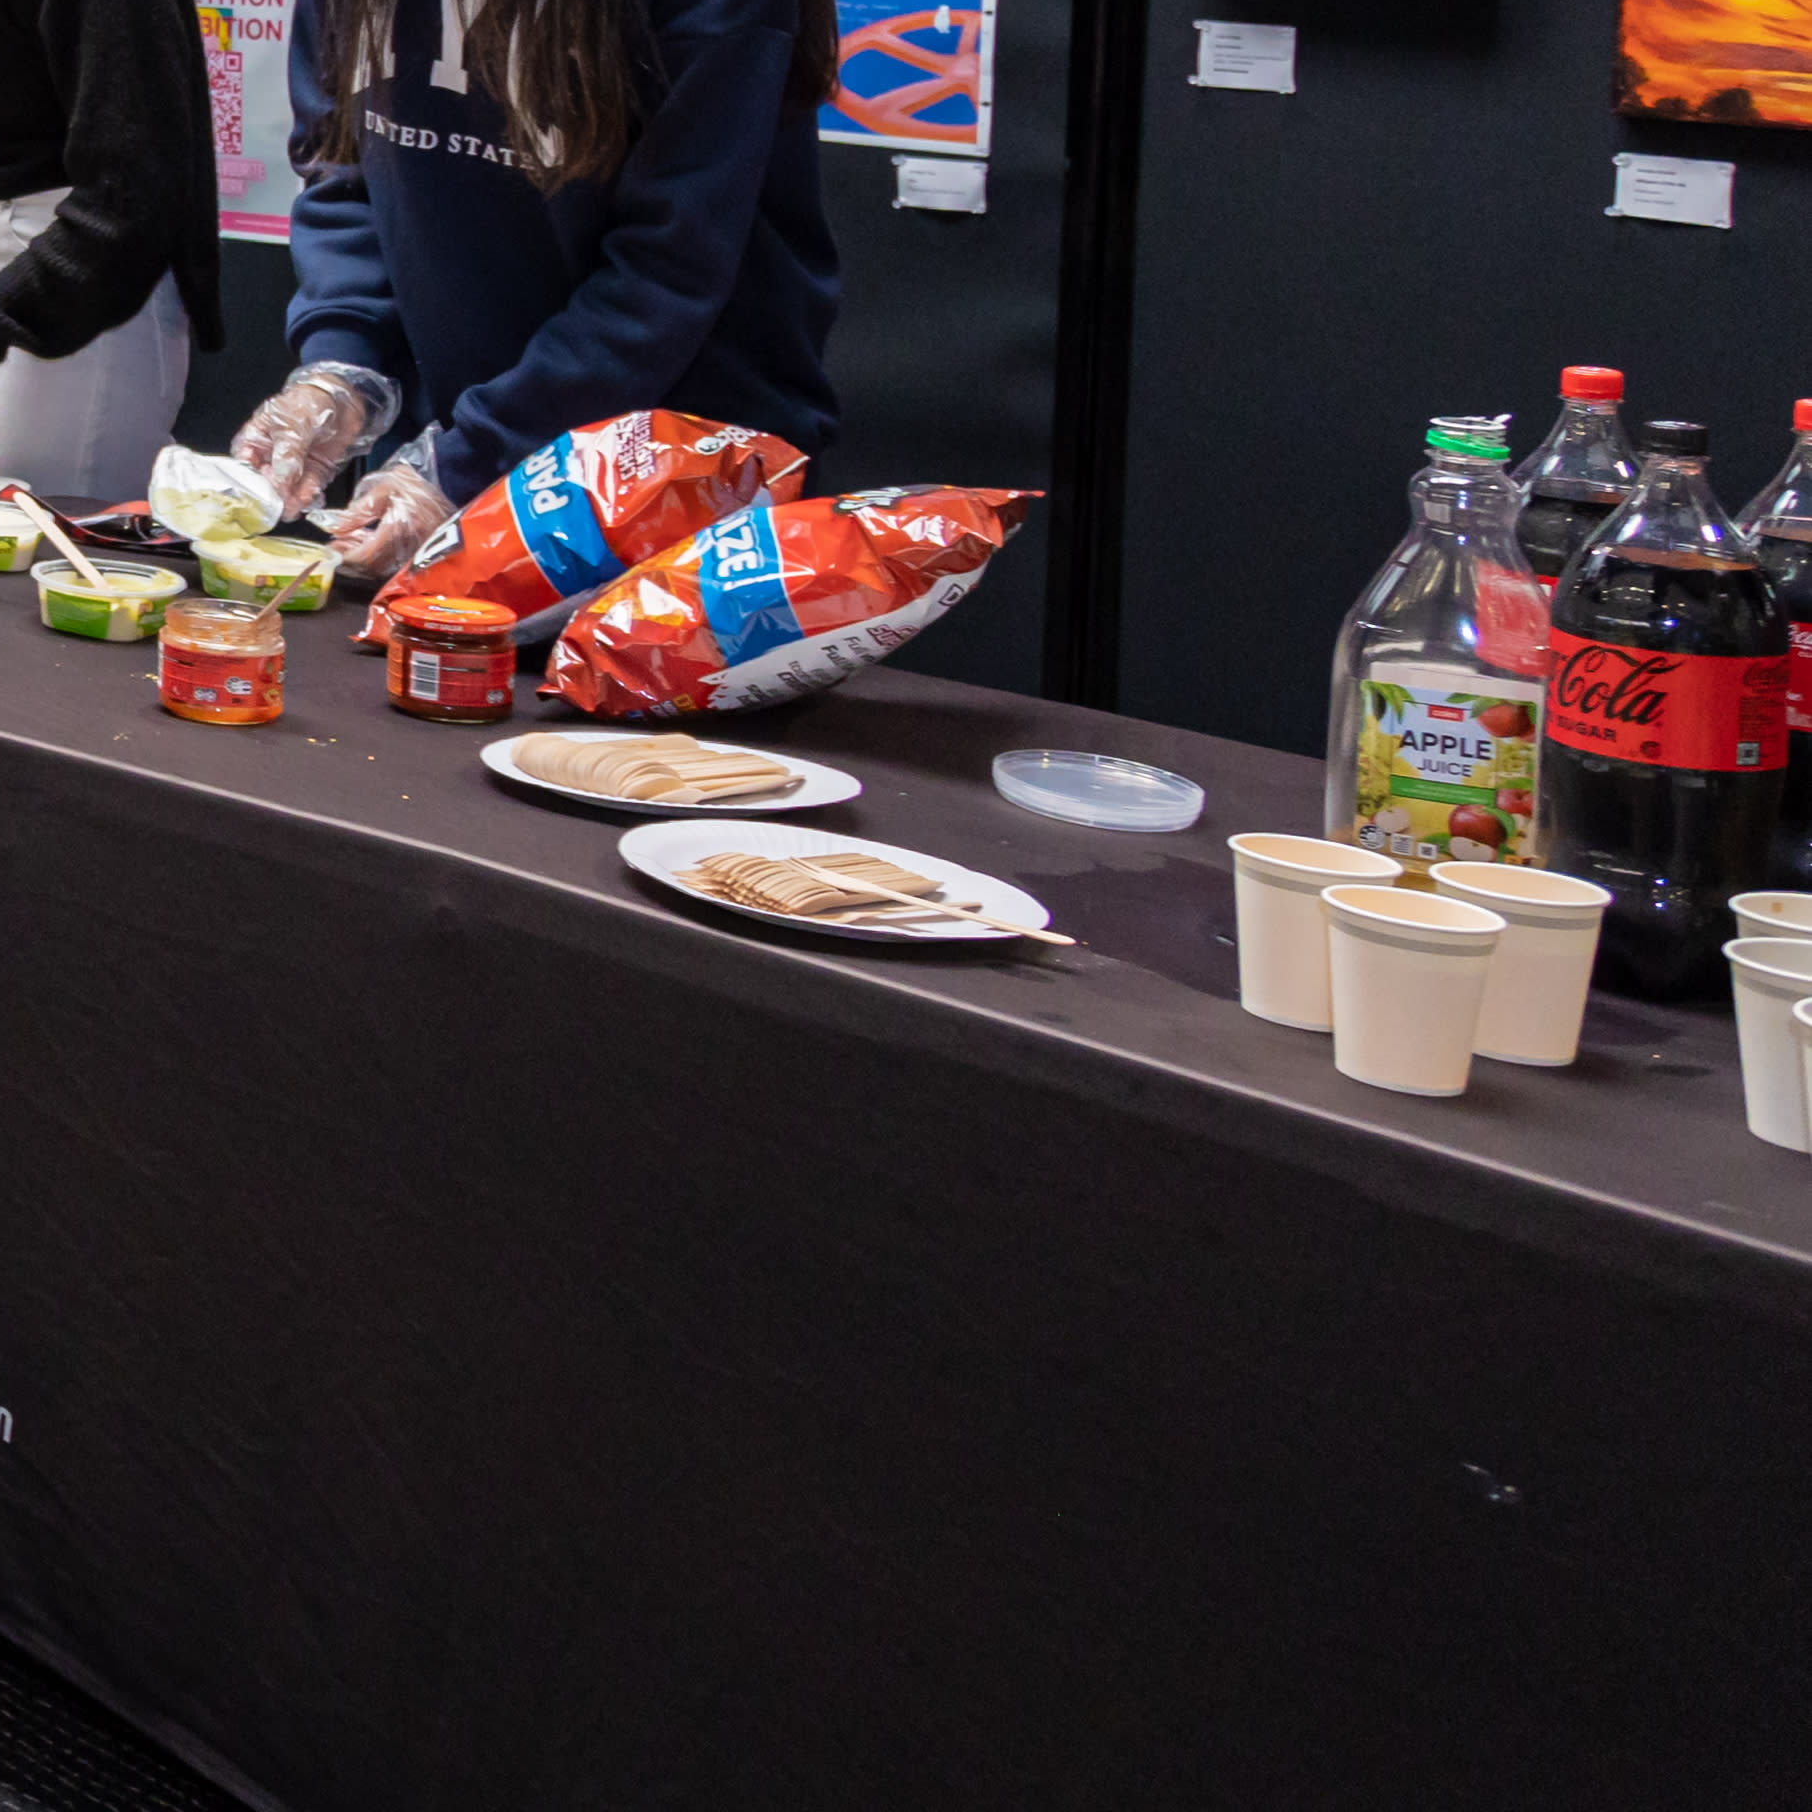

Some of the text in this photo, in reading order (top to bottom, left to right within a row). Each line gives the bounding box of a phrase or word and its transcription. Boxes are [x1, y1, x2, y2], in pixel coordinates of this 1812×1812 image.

[365, 110, 438, 149] UNTED
[1559, 645, 1684, 725] Cola
[1400, 729, 1492, 761] APPLE
[1557, 714, 1617, 744] SUGAR
[1417, 758, 1472, 778] JUICE
